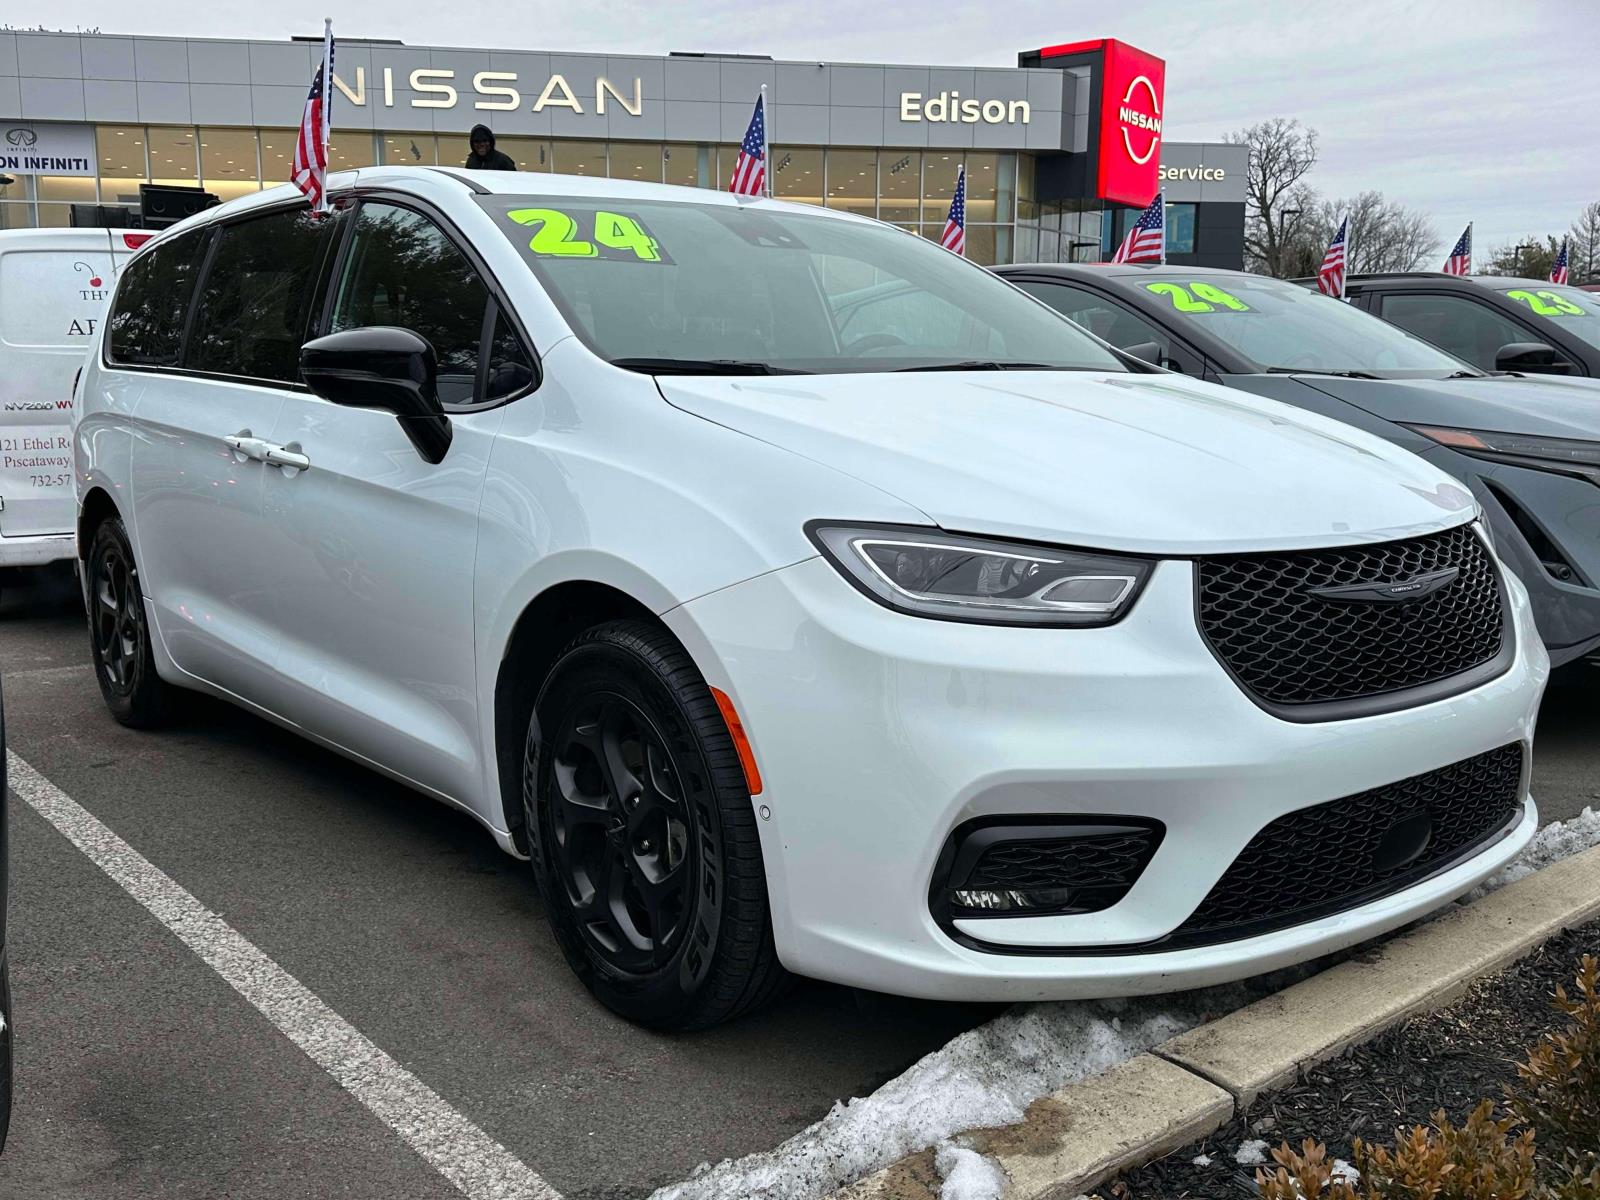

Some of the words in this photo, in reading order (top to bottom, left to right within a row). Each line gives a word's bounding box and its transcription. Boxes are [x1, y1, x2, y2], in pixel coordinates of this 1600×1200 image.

[332, 66, 642, 116] NISSAN
[900, 91, 1031, 124] Edison
[1120, 106, 1162, 133] NISSAN
[25, 156, 88, 171] INFINITI
[1158, 164, 1225, 181] Service
[506, 208, 662, 262] 24
[80, 290, 109, 301] TH
[1146, 282, 1250, 312] 24
[1506, 290, 1586, 316] 23
[5, 402, 54, 411] NV200
[0, 439, 18, 451] 121
[24, 437, 54, 450] Ethel
[4, 456, 70, 469] Piscataway
